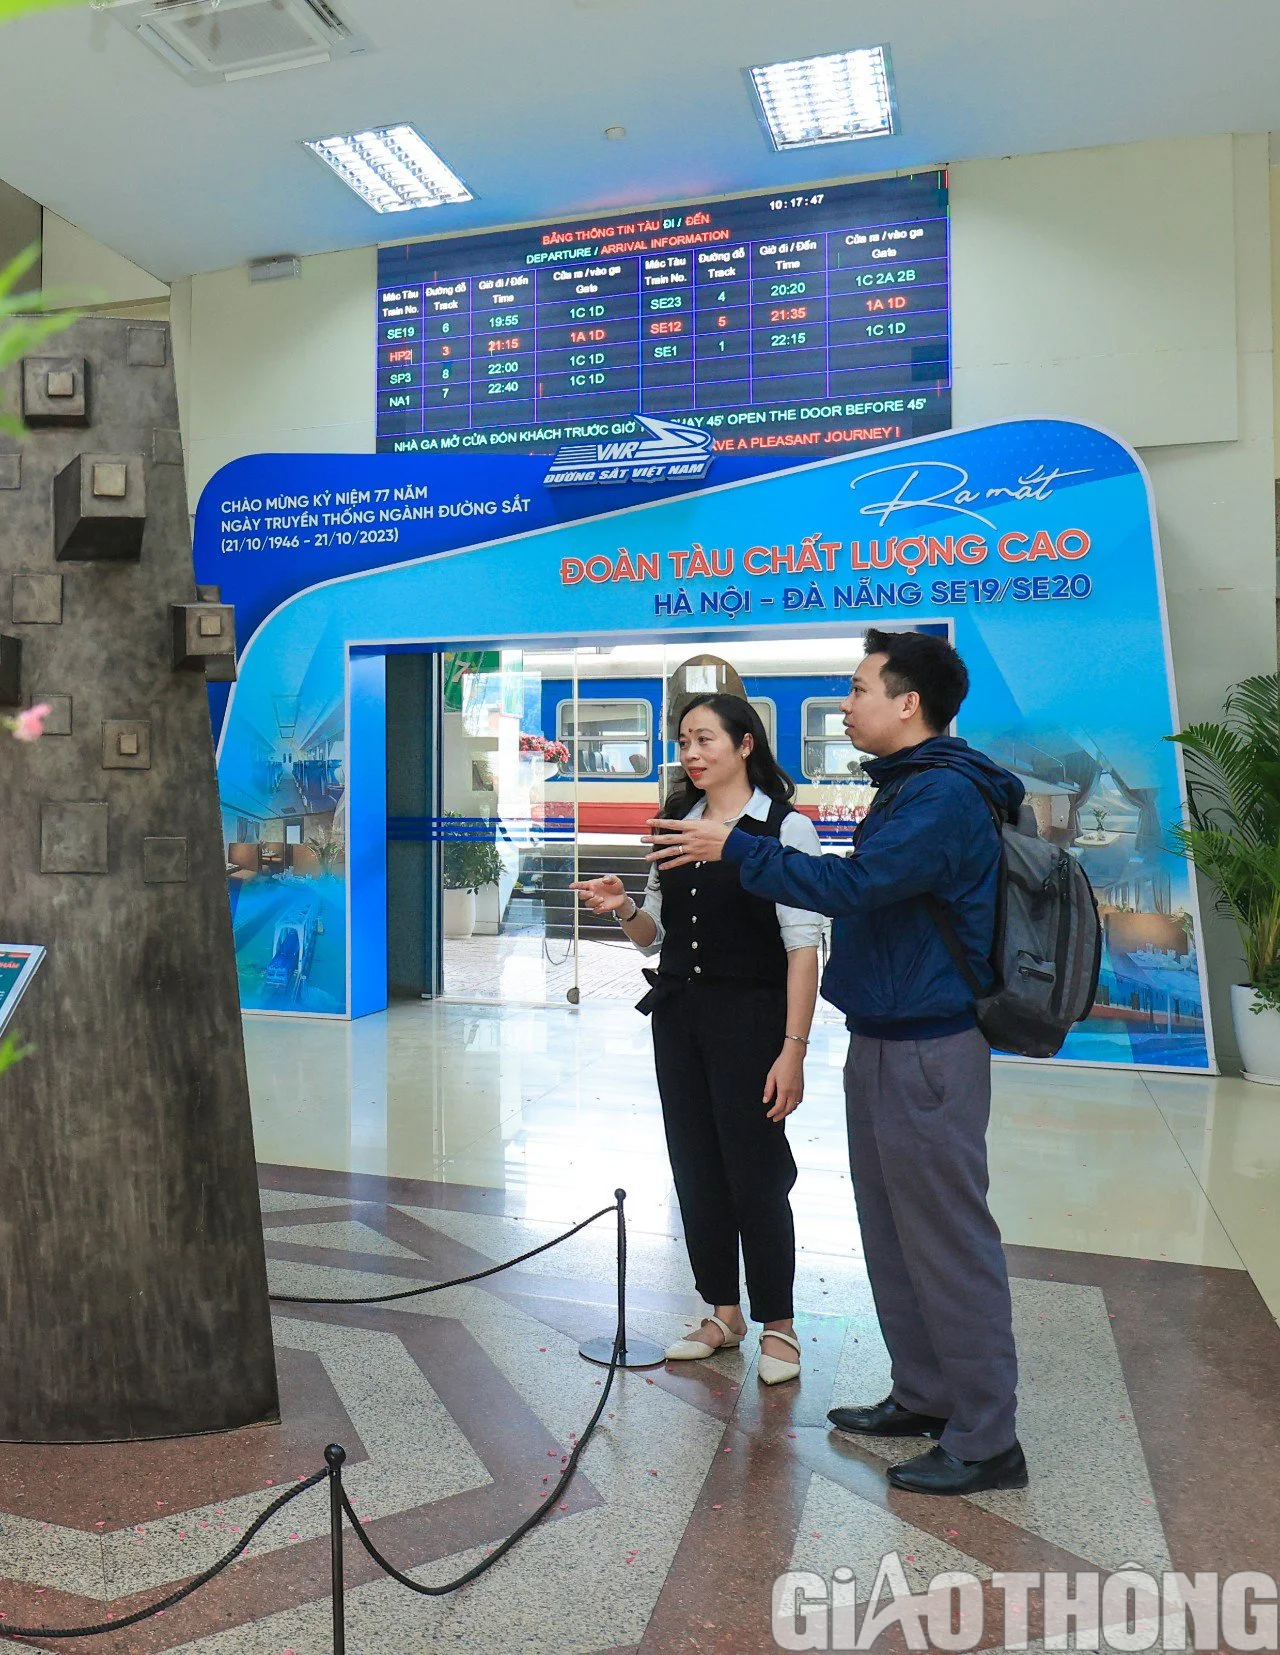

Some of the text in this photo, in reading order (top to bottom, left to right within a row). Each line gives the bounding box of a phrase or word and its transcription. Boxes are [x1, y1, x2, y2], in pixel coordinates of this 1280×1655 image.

[575, 226, 615, 240] THÔNG
[617, 223, 635, 235] TIN
[637, 219, 660, 232] TÀU
[663, 218, 675, 229] ĐI
[685, 211, 710, 226] ĐẾN
[526, 230, 729, 264] DEPARTURE ARRIVAL INFORMATION
[871, 248, 897, 259] Gate
[775, 260, 801, 271] Time
[645, 272, 687, 286] Train No.
[708, 267, 736, 278] Track
[855, 269, 916, 287] 1C 2A 2B
[575, 284, 598, 294] Gate
[770, 282, 806, 296] 20:20
[492, 294, 515, 304] Time
[650, 296, 682, 310] SE23
[717, 291, 726, 302] 4
[434, 300, 459, 311] Track
[866, 296, 906, 311] 1A 1D
[382, 305, 419, 317] Train No.
[570, 305, 605, 319] 1C 1D
[771, 307, 806, 322] 21:35
[442, 323, 450, 333] 6
[489, 315, 519, 328] 19:55
[650, 321, 682, 334] SE12
[718, 316, 726, 327] 5
[387, 327, 415, 339] SE19
[571, 329, 605, 343] 1A 1D
[866, 322, 906, 337] 1C 1D
[488, 338, 519, 351] 21:15
[771, 332, 806, 347] 22:15
[442, 346, 450, 356] 3
[654, 346, 677, 358] SE1
[719, 341, 725, 352] 1
[389, 350, 412, 362] HP2
[570, 353, 605, 367] 1C 1D
[442, 369, 450, 379] 8
[488, 362, 519, 375] 22:00
[389, 373, 412, 384] SP3
[570, 373, 605, 386] 1C 1D
[442, 388, 450, 398] 7
[488, 381, 519, 394] 22:40
[389, 396, 411, 407] NA1
[394, 436, 418, 452] NHÀ
[420, 436, 438, 450] GA
[440, 433, 460, 449] MỞ
[462, 433, 488, 447] CỬA
[490, 429, 517, 444] ĐÓN
[519, 426, 561, 442] KHÁCH
[564, 421, 609, 438] TRƯỚC
[611, 419, 636, 434] GIỜ
[729, 411, 766, 425] OPEN
[769, 408, 797, 422] THE
[800, 405, 842, 419] DOOR
[845, 401, 904, 417] BEFORE
[737, 428, 892, 449] A PLEASANT JOURNEY
[596, 441, 640, 461] VNR
[544, 463, 705, 484] ĐƯỜNG SẮT VIỆT NAM
[221, 485, 428, 514] CHÀO MỪNG KỶ NIỆM 77 NĂM
[850, 461, 1095, 531] Ra mắt
[221, 494, 532, 533] NGÀY TRUYỀN THỐNG NGÀNH ĐƯỜNG SẮT
[221, 528, 399, 554] (21/10/1946 21/10/2023)
[560, 528, 1092, 585] ĐOÀN TÀU CHẤT LƯỢNG CAO
[654, 573, 1092, 619] HÀ NỘI ĐÀ NẴNG SE19/SE20
